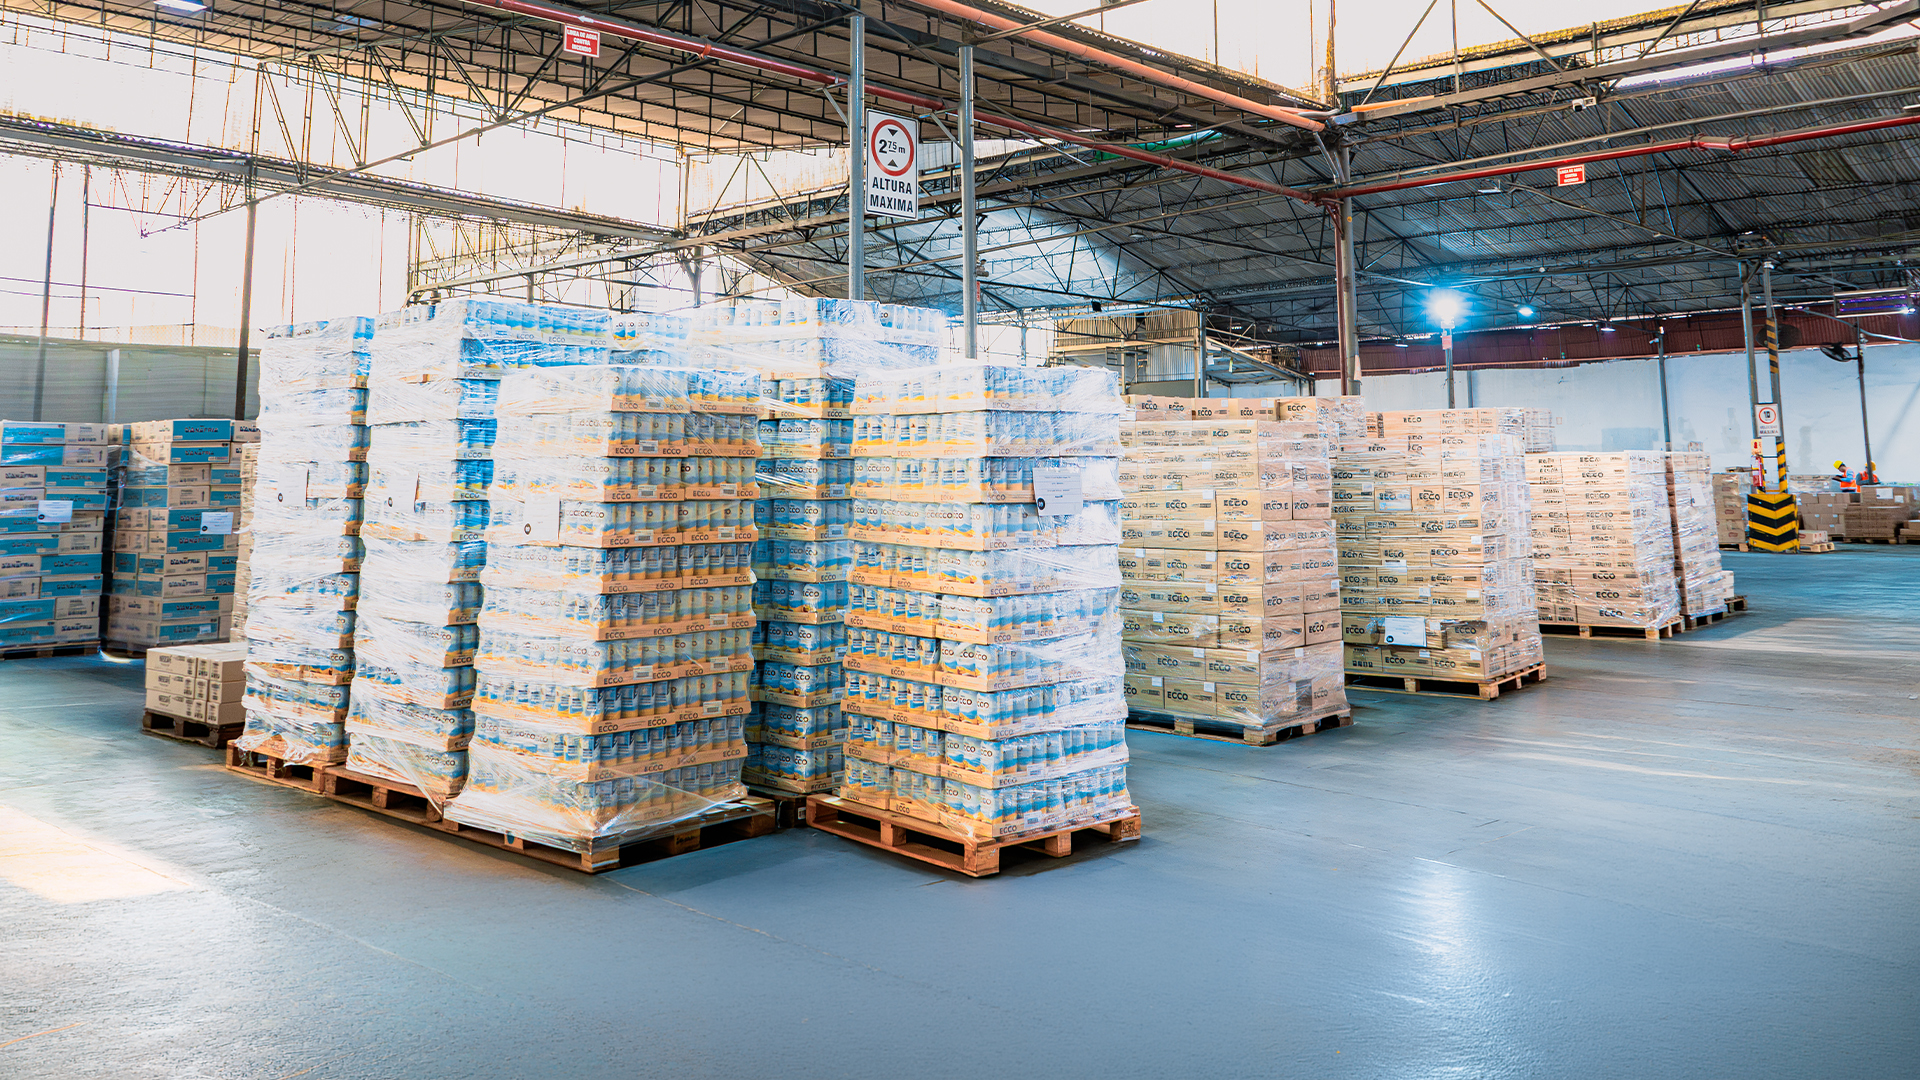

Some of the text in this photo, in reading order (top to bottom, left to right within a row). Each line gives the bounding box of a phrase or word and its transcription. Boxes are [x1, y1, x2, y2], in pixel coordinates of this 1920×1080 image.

[872, 176, 912, 195] ALTURA
[870, 194, 914, 213] MAXIMA
[1141, 402, 1158, 410] ECCO
[1166, 501, 1187, 509] ECCO
[1223, 499, 1249, 507] ECCO
[1168, 530, 1190, 538] ECCO
[1223, 531, 1248, 540] ECCO
[1166, 561, 1187, 569] ECCO
[1225, 562, 1250, 570] ECCO
[1592, 572, 1616, 580] ECCO
[608, 585, 628, 593] ECCO
[1223, 595, 1249, 603] ECCO
[820, 614, 836, 622] ECCO
[891, 624, 906, 632] ECCO
[1168, 626, 1190, 634] ECCO
[1228, 625, 1251, 634] ECCO
[1308, 624, 1324, 633] ECCO
[605, 631, 625, 639] ECCO
[1265, 631, 1282, 639] ECCO
[452, 656, 472, 664] ECCO
[816, 656, 831, 664] ECCO
[847, 660, 861, 668] ECCO
[1157, 657, 1178, 666] ECCO
[1385, 657, 1405, 665] ECCO
[1208, 663, 1231, 672] ECCO
[652, 671, 671, 679] ECCO
[685, 668, 703, 676] ECCO
[890, 668, 905, 676] ECCO
[603, 677, 623, 685] ECCO
[1167, 691, 1189, 700] ECCO
[1225, 692, 1248, 701] ECCO
[1313, 690, 1329, 699] ECCO
[452, 698, 471, 706] ECCO
[811, 698, 827, 706] ECCO
[725, 707, 743, 715] ECCO
[846, 703, 861, 712] ECCO
[679, 712, 698, 720] ECCO
[893, 713, 908, 722] ECCO
[647, 718, 667, 726] ECCO
[598, 724, 618, 733] ECCO
[811, 740, 827, 748] ECCO
[722, 749, 740, 757] ECCO
[847, 747, 862, 756] ECCO
[644, 764, 663, 772] ECCO
[895, 804, 910, 814] ECCO
[999, 825, 1017, 834] ECCO
